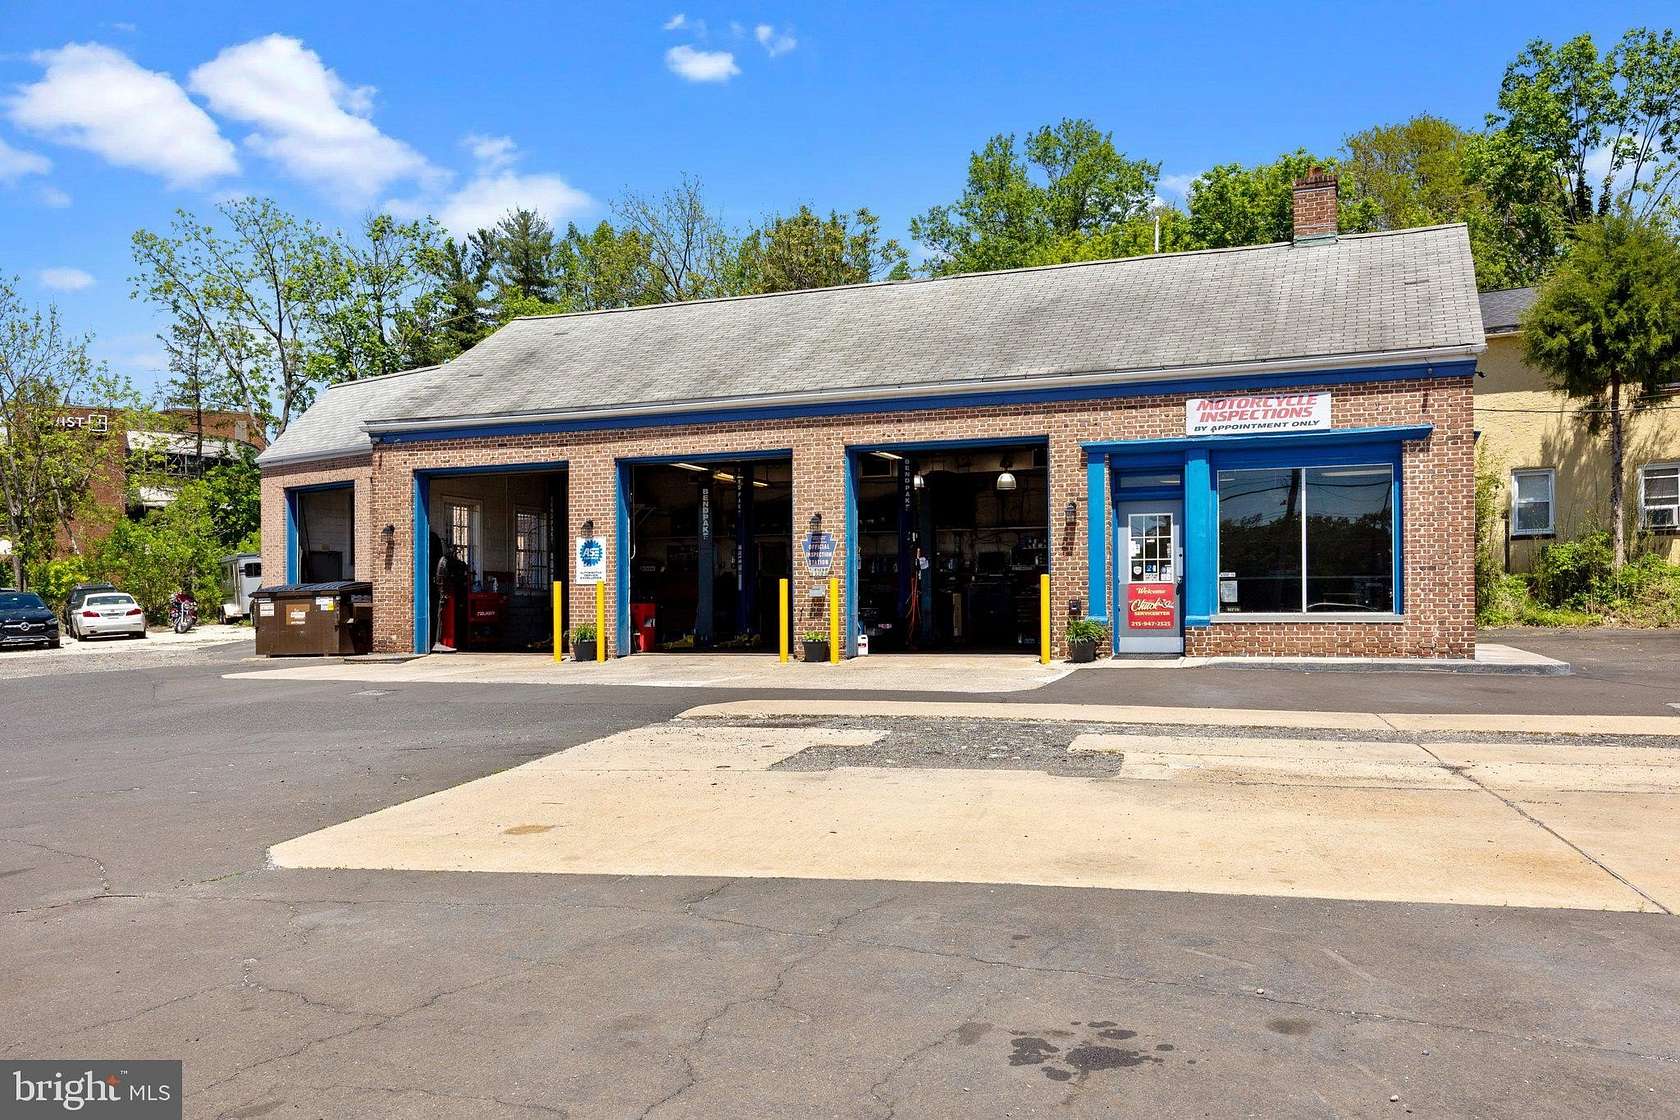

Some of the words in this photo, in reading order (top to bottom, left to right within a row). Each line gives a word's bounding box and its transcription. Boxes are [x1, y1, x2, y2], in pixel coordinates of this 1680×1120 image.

[1196, 395, 1318, 411] MOTORCYCLE
[1199, 406, 1313, 423] INSPECTIONS
[1210, 421, 1289, 433] APPOINTMENT
[1291, 419, 1321, 427] ONLY
[584, 547, 600, 557] ASE
[808, 543, 830, 551] OFFICIAL
